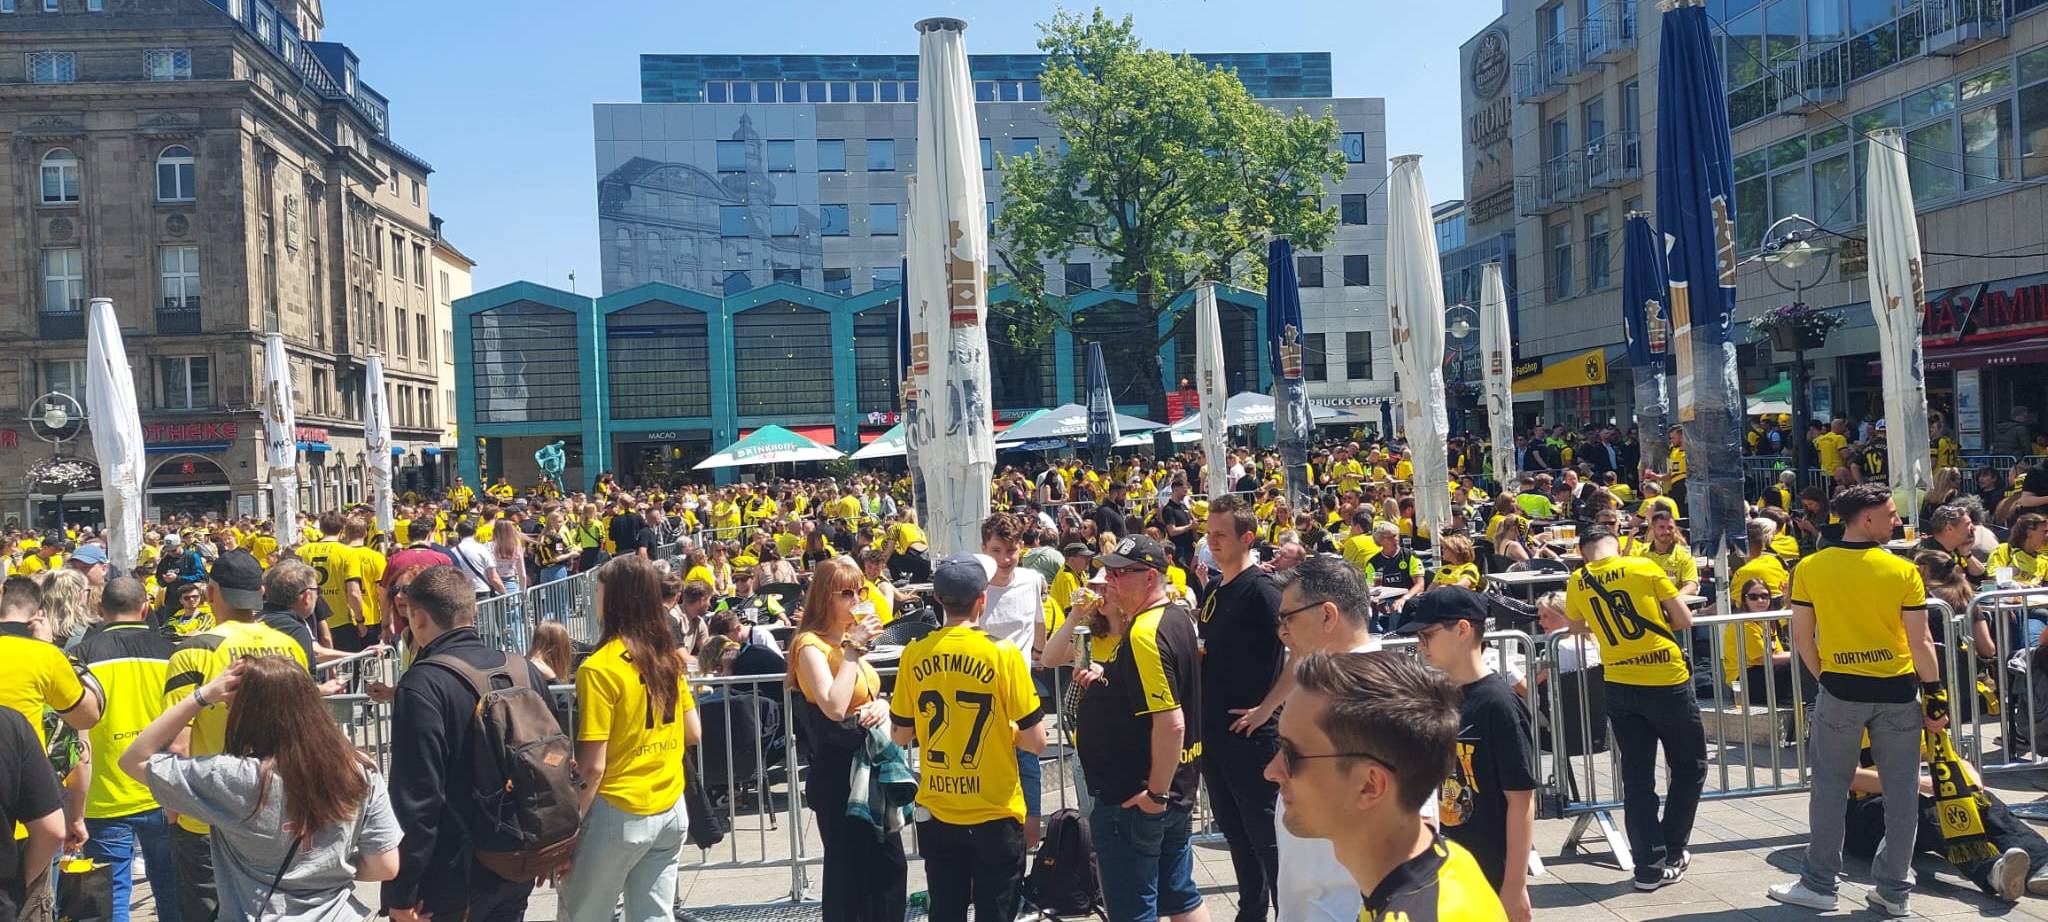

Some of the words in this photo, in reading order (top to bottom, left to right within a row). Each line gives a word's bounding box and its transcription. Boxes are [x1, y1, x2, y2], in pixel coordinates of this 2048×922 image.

[1309, 397, 1352, 406] RBUCKS
[648, 431, 677, 440] MACAO
[1578, 567, 1626, 591] BEKANT
[1833, 648, 1893, 665] DORTMUND
[913, 653, 995, 684] DORTMUND
[917, 690, 996, 769] 27
[929, 775, 980, 794] ADEYEMI
